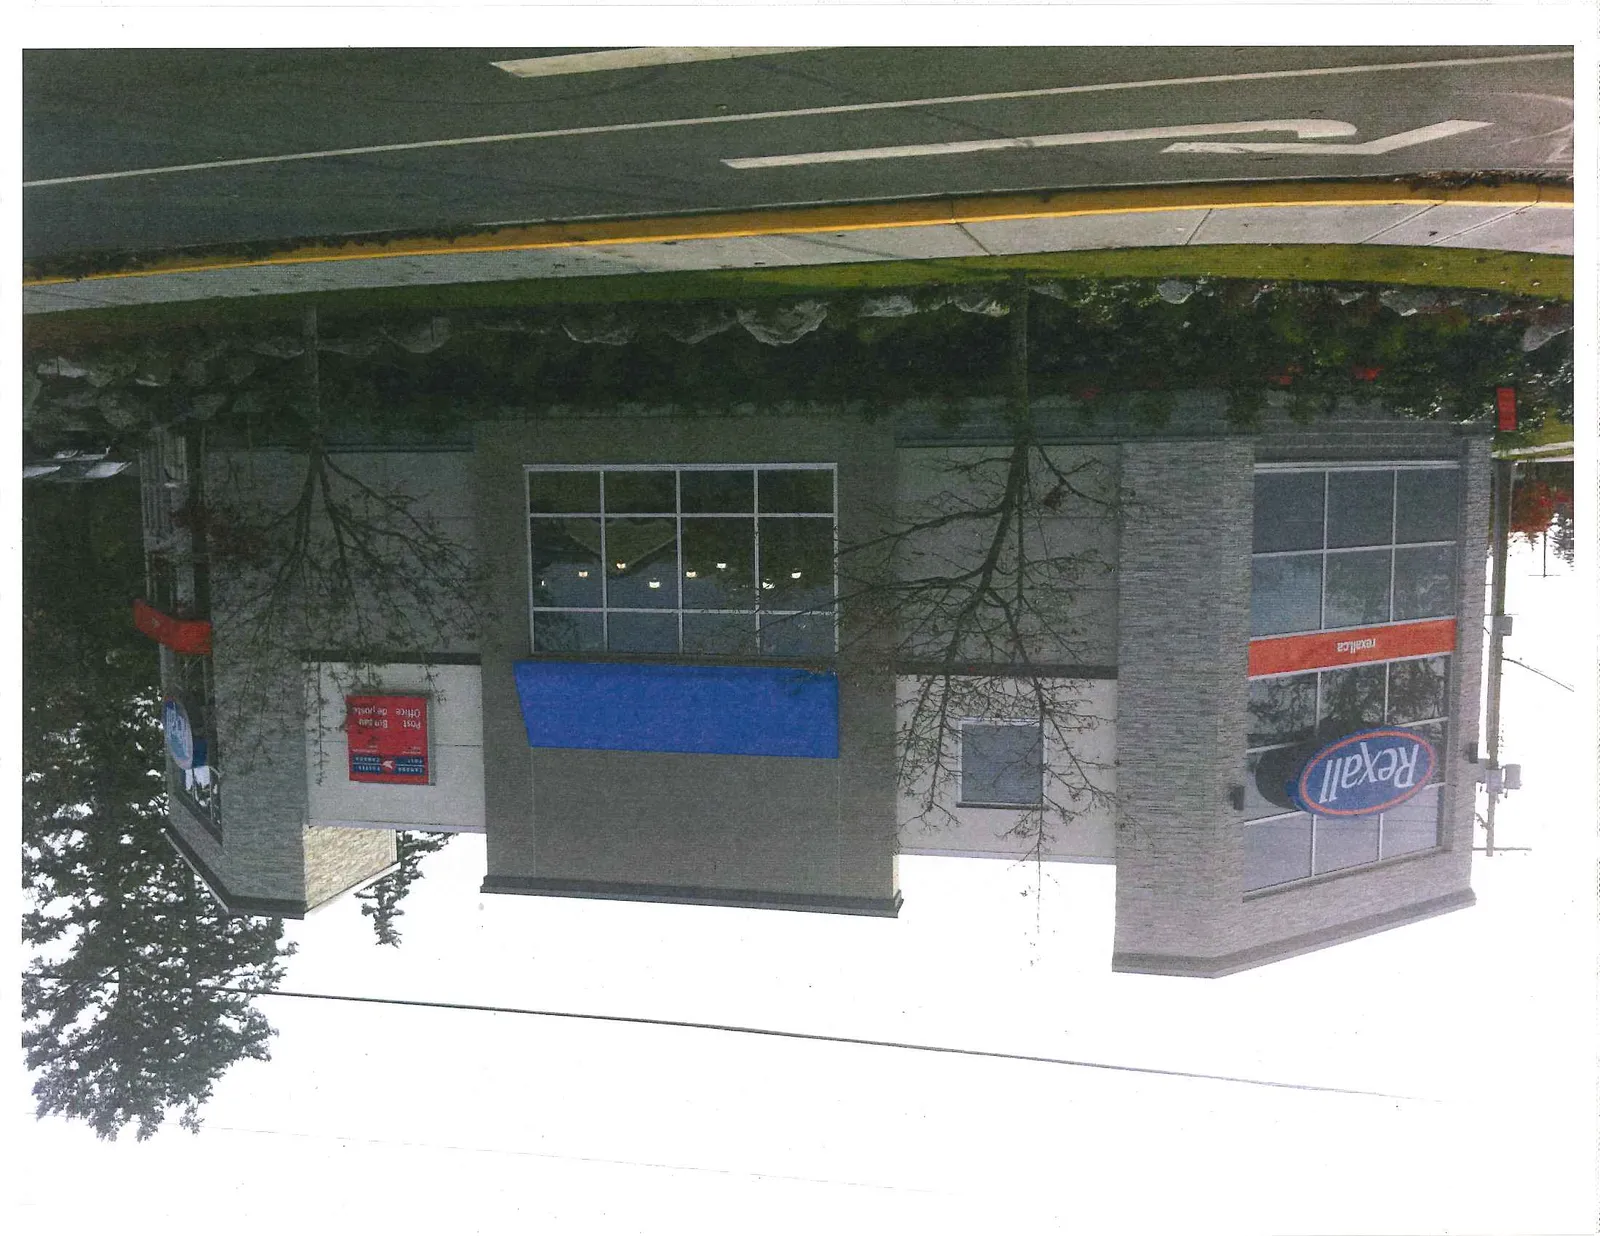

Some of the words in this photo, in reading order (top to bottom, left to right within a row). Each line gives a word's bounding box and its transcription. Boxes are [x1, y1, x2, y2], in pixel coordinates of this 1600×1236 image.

[1337, 638, 1376, 654] rexall.ca
[395, 708, 421, 718] Office
[402, 720, 421, 730] Post
[1318, 742, 1419, 804] Rexall
